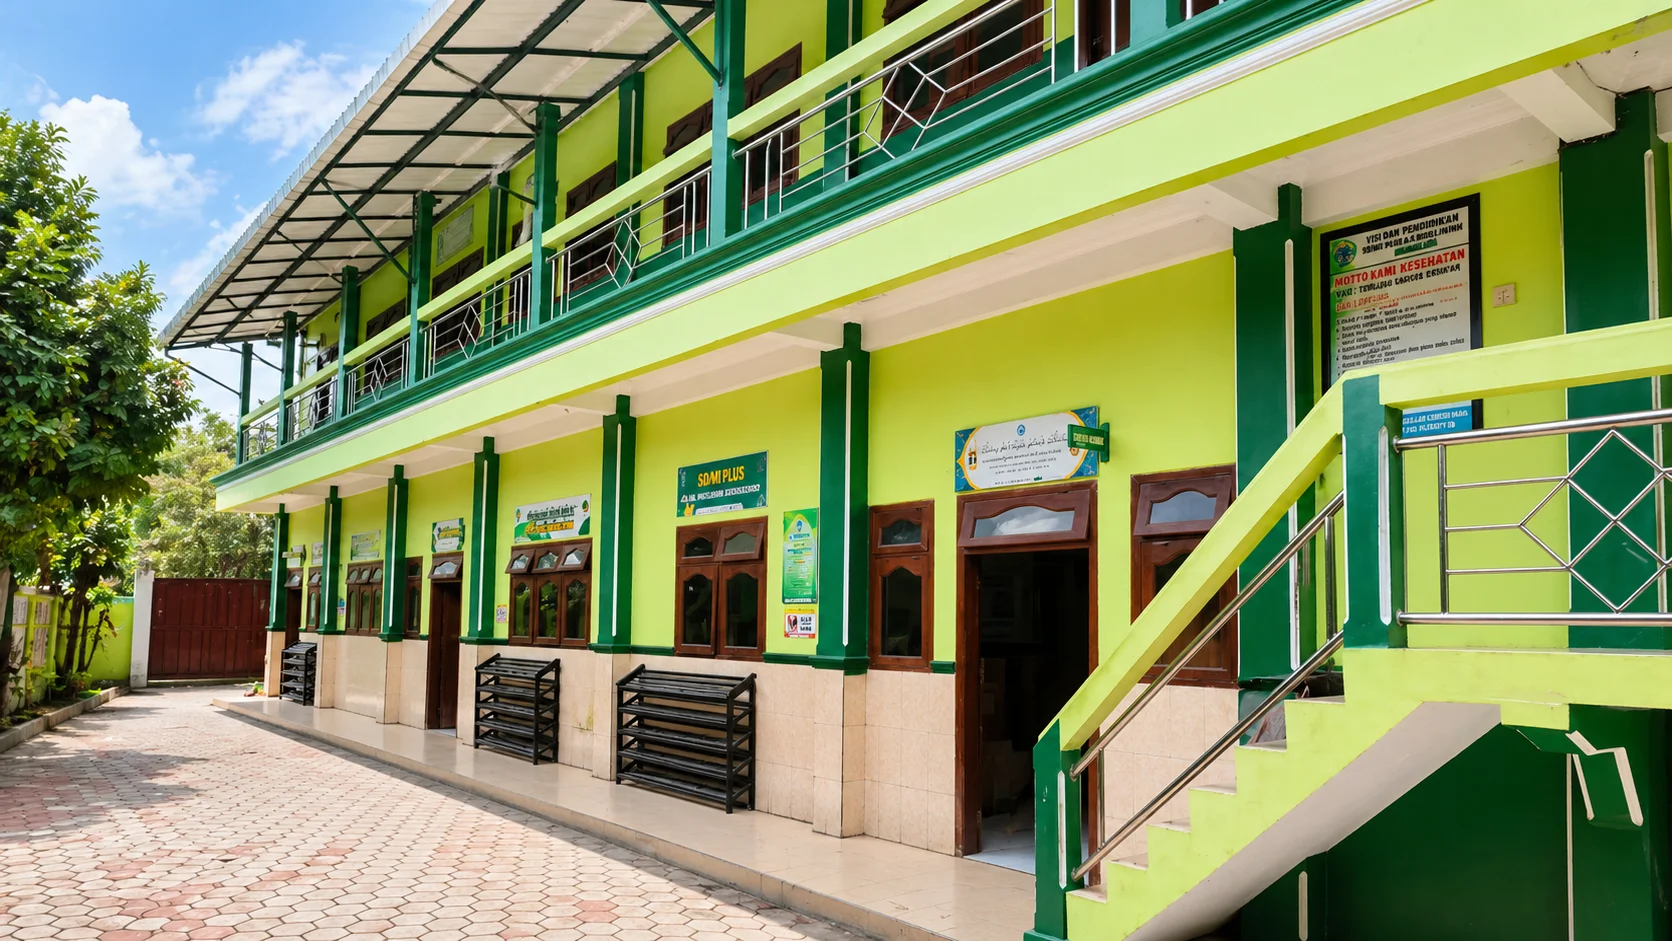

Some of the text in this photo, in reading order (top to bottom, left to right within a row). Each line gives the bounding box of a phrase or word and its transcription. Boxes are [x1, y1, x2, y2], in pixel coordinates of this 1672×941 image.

[1334, 272, 1368, 288] MOTTO
[1370, 265, 1396, 280] KAMI
[1400, 248, 1465, 273] KESEHATAN
[722, 465, 745, 483] PLUS
